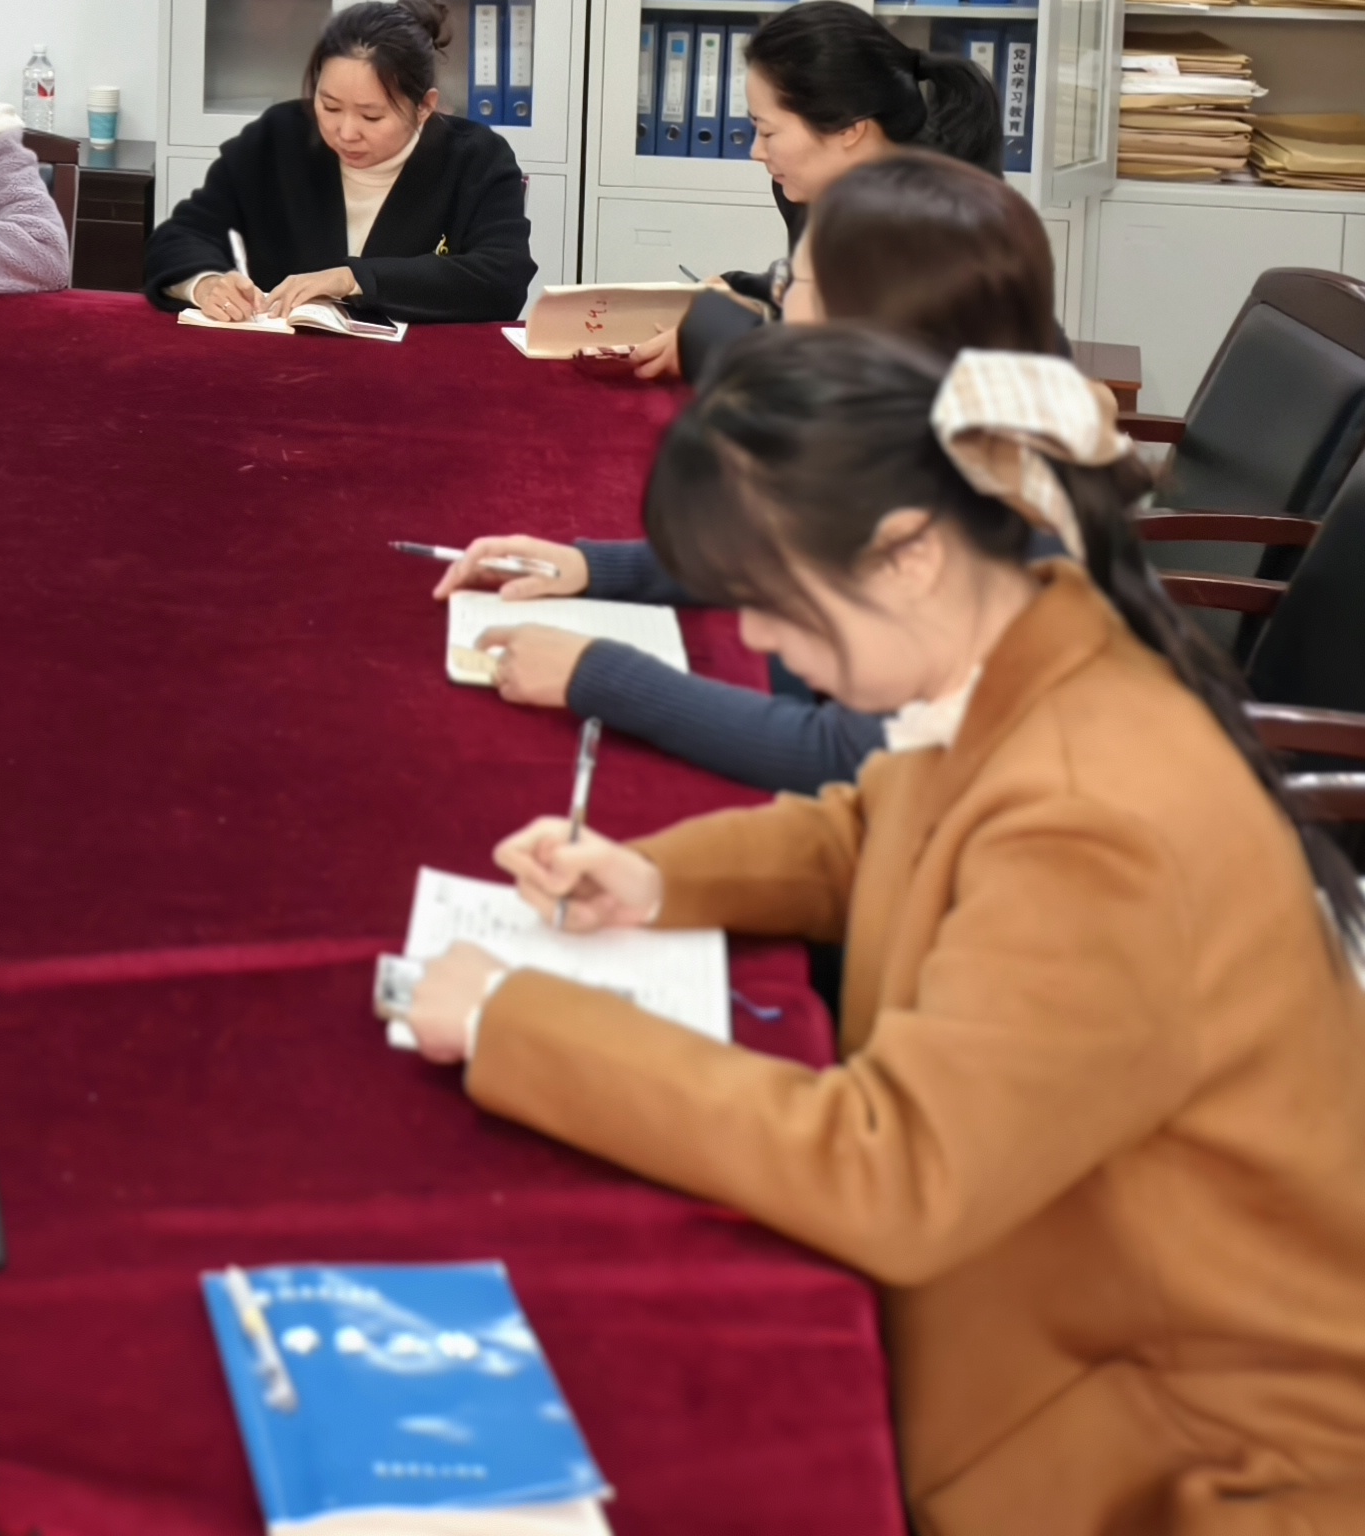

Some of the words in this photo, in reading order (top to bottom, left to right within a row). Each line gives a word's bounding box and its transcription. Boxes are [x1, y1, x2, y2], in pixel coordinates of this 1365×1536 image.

[1009, 48, 1027, 133] 党史学习教育
